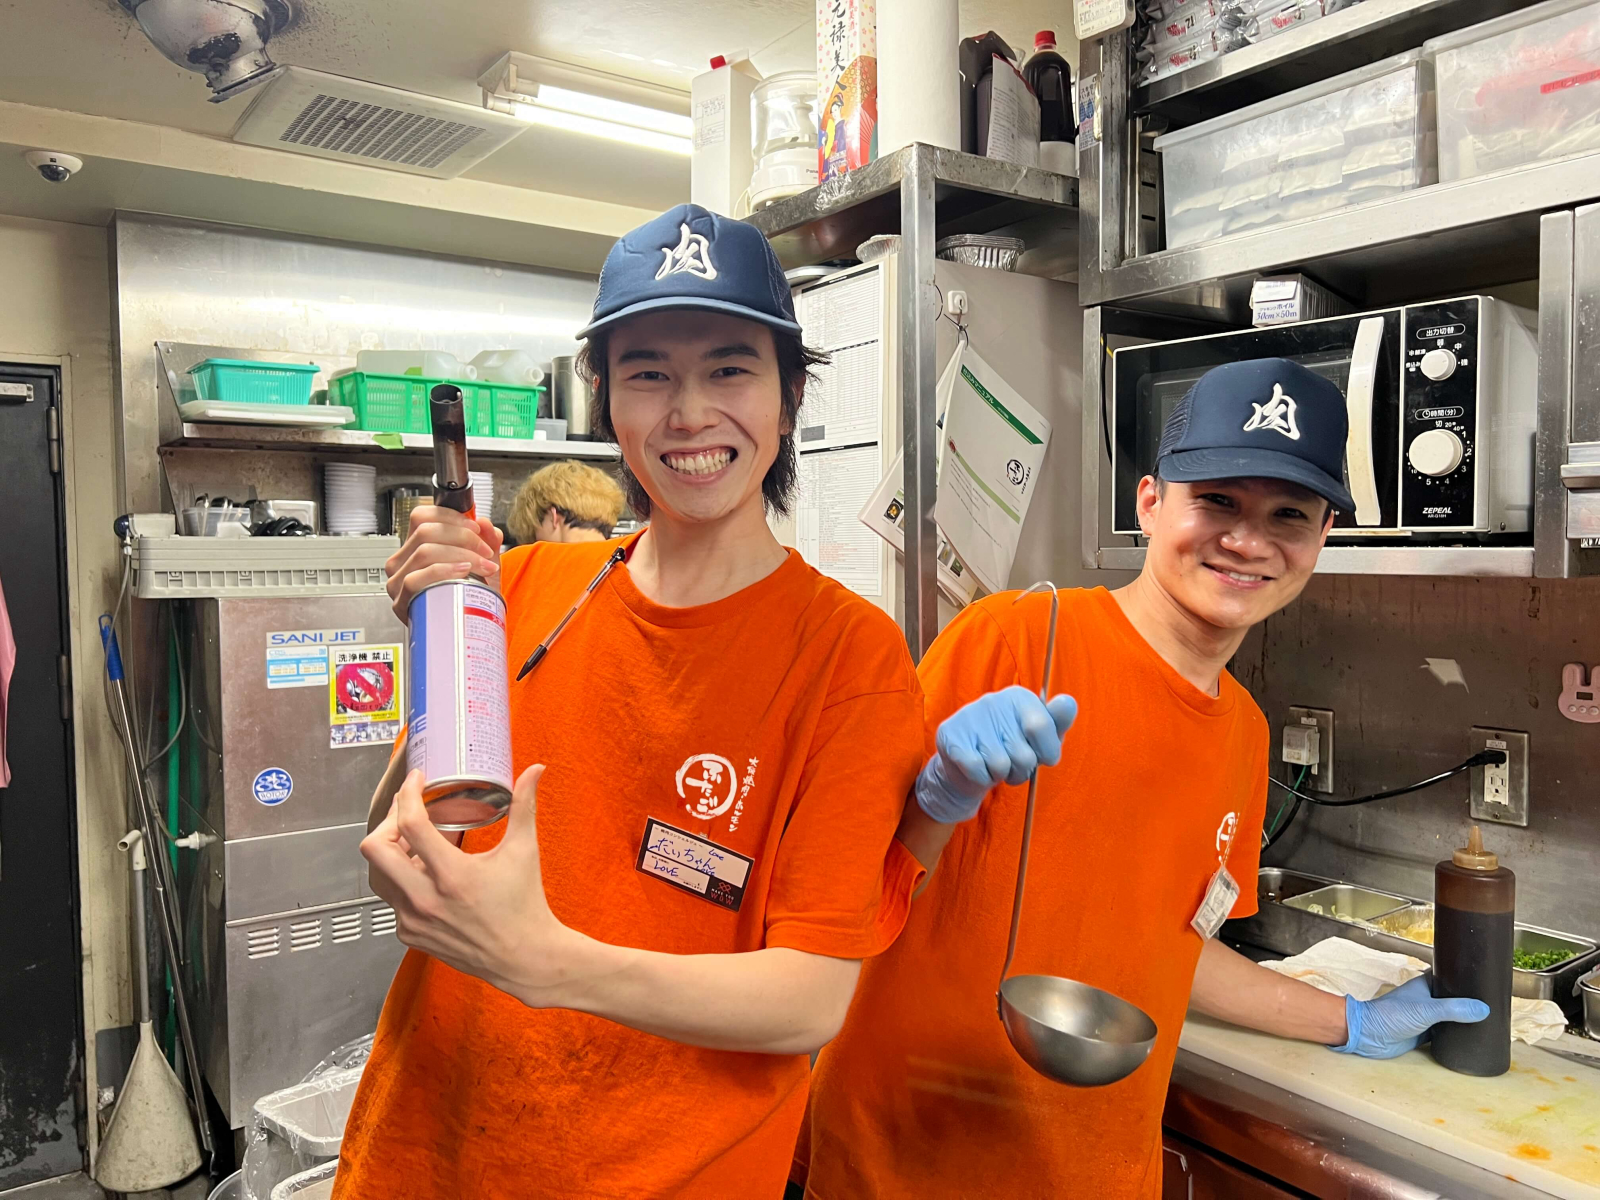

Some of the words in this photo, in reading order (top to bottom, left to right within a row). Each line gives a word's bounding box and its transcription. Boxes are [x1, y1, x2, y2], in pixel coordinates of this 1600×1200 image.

[655, 223, 717, 280] 肉
[1426, 327, 1454, 337] 出力切替
[1243, 383, 1300, 440] 肉
[271, 632, 323, 645] SANI
[328, 631, 361, 642] JET
[338, 653, 368, 663] 洗浄機
[372, 652, 391, 661] 禁止
[685, 760, 723, 813] ふたご
